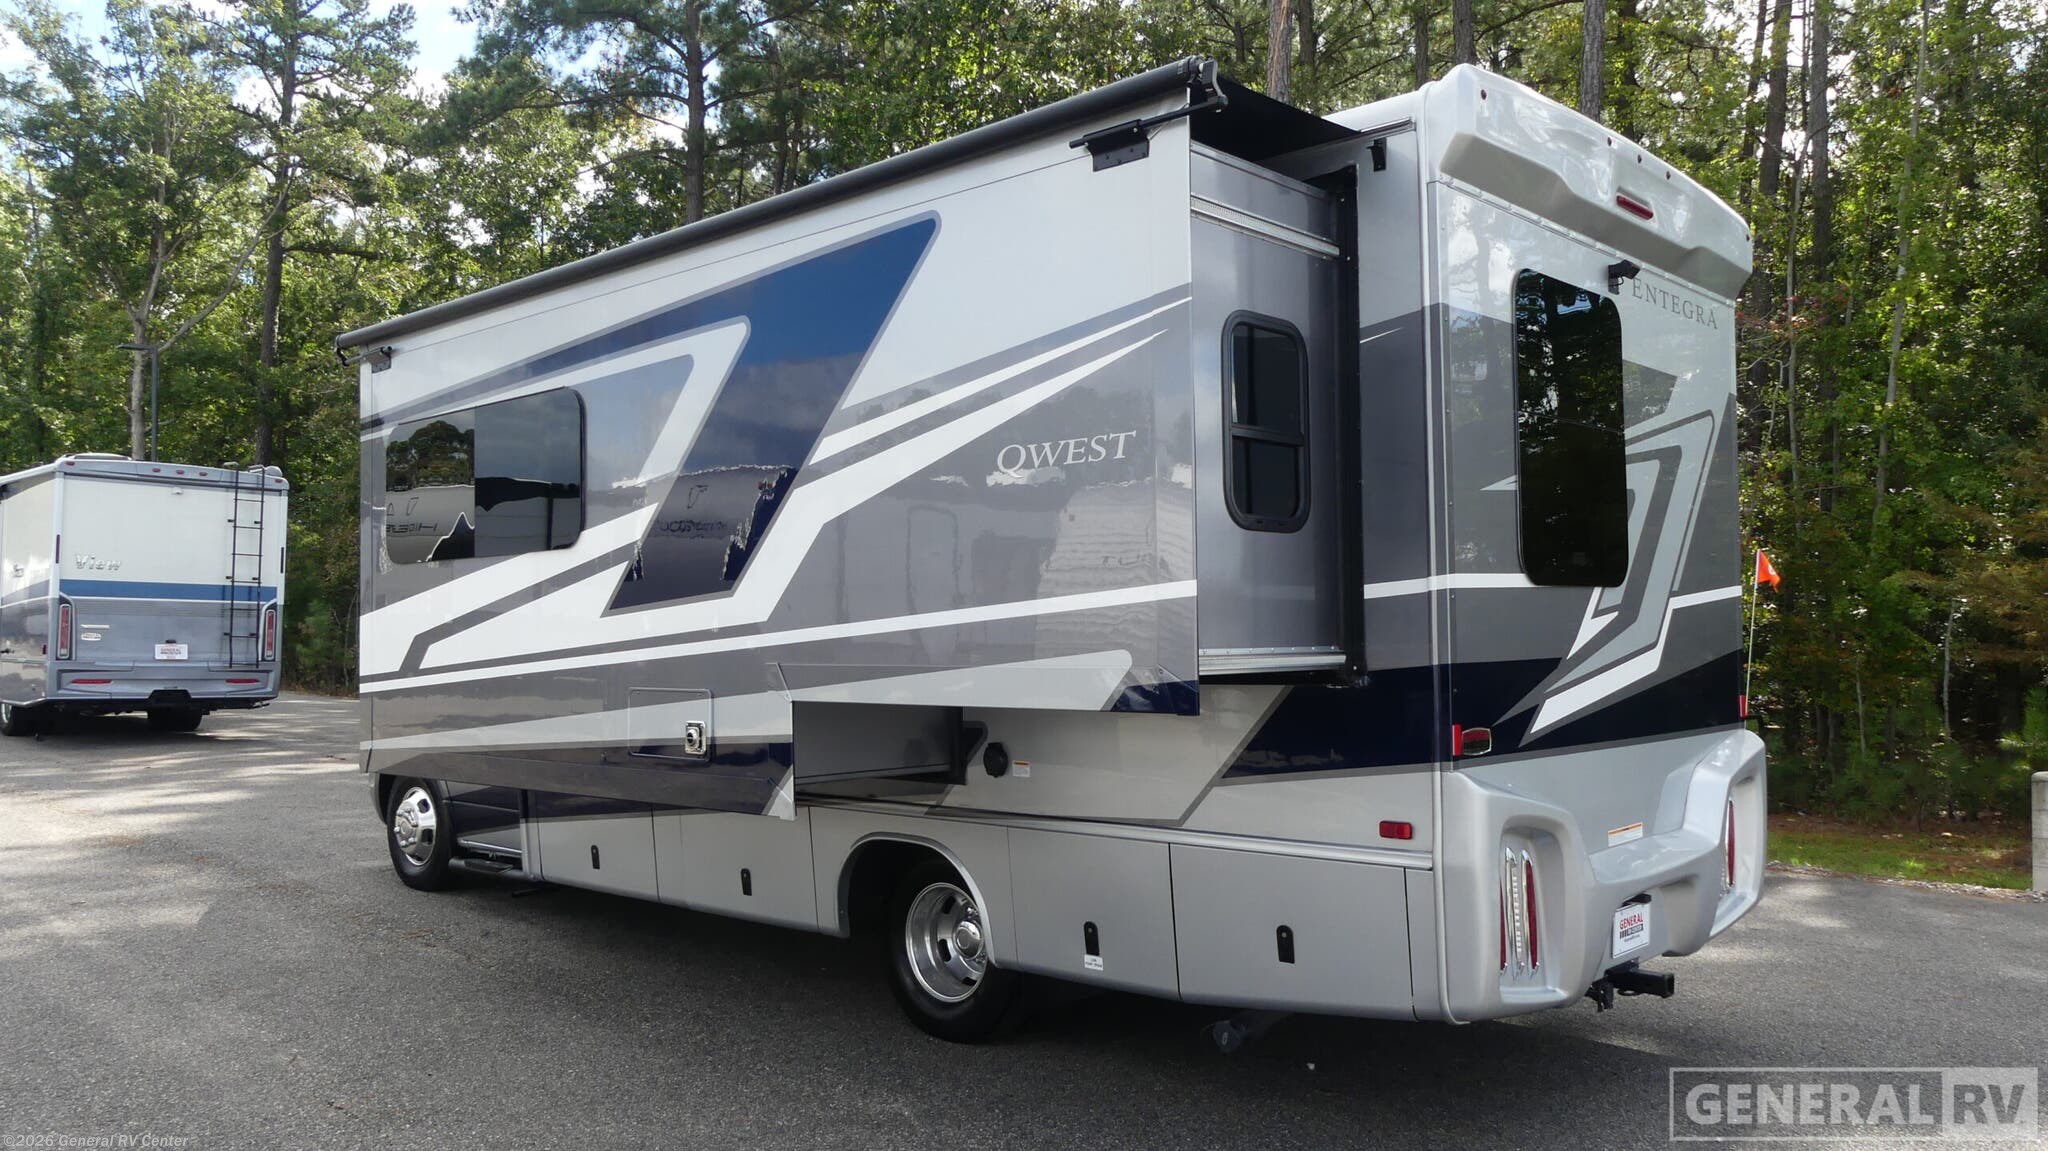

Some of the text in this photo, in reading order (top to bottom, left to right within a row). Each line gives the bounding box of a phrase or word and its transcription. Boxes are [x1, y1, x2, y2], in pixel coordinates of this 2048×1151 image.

[1631, 277, 1718, 330] ENTEGRA
[996, 430, 1137, 478] QWEST
[75, 553, 121, 571] View
